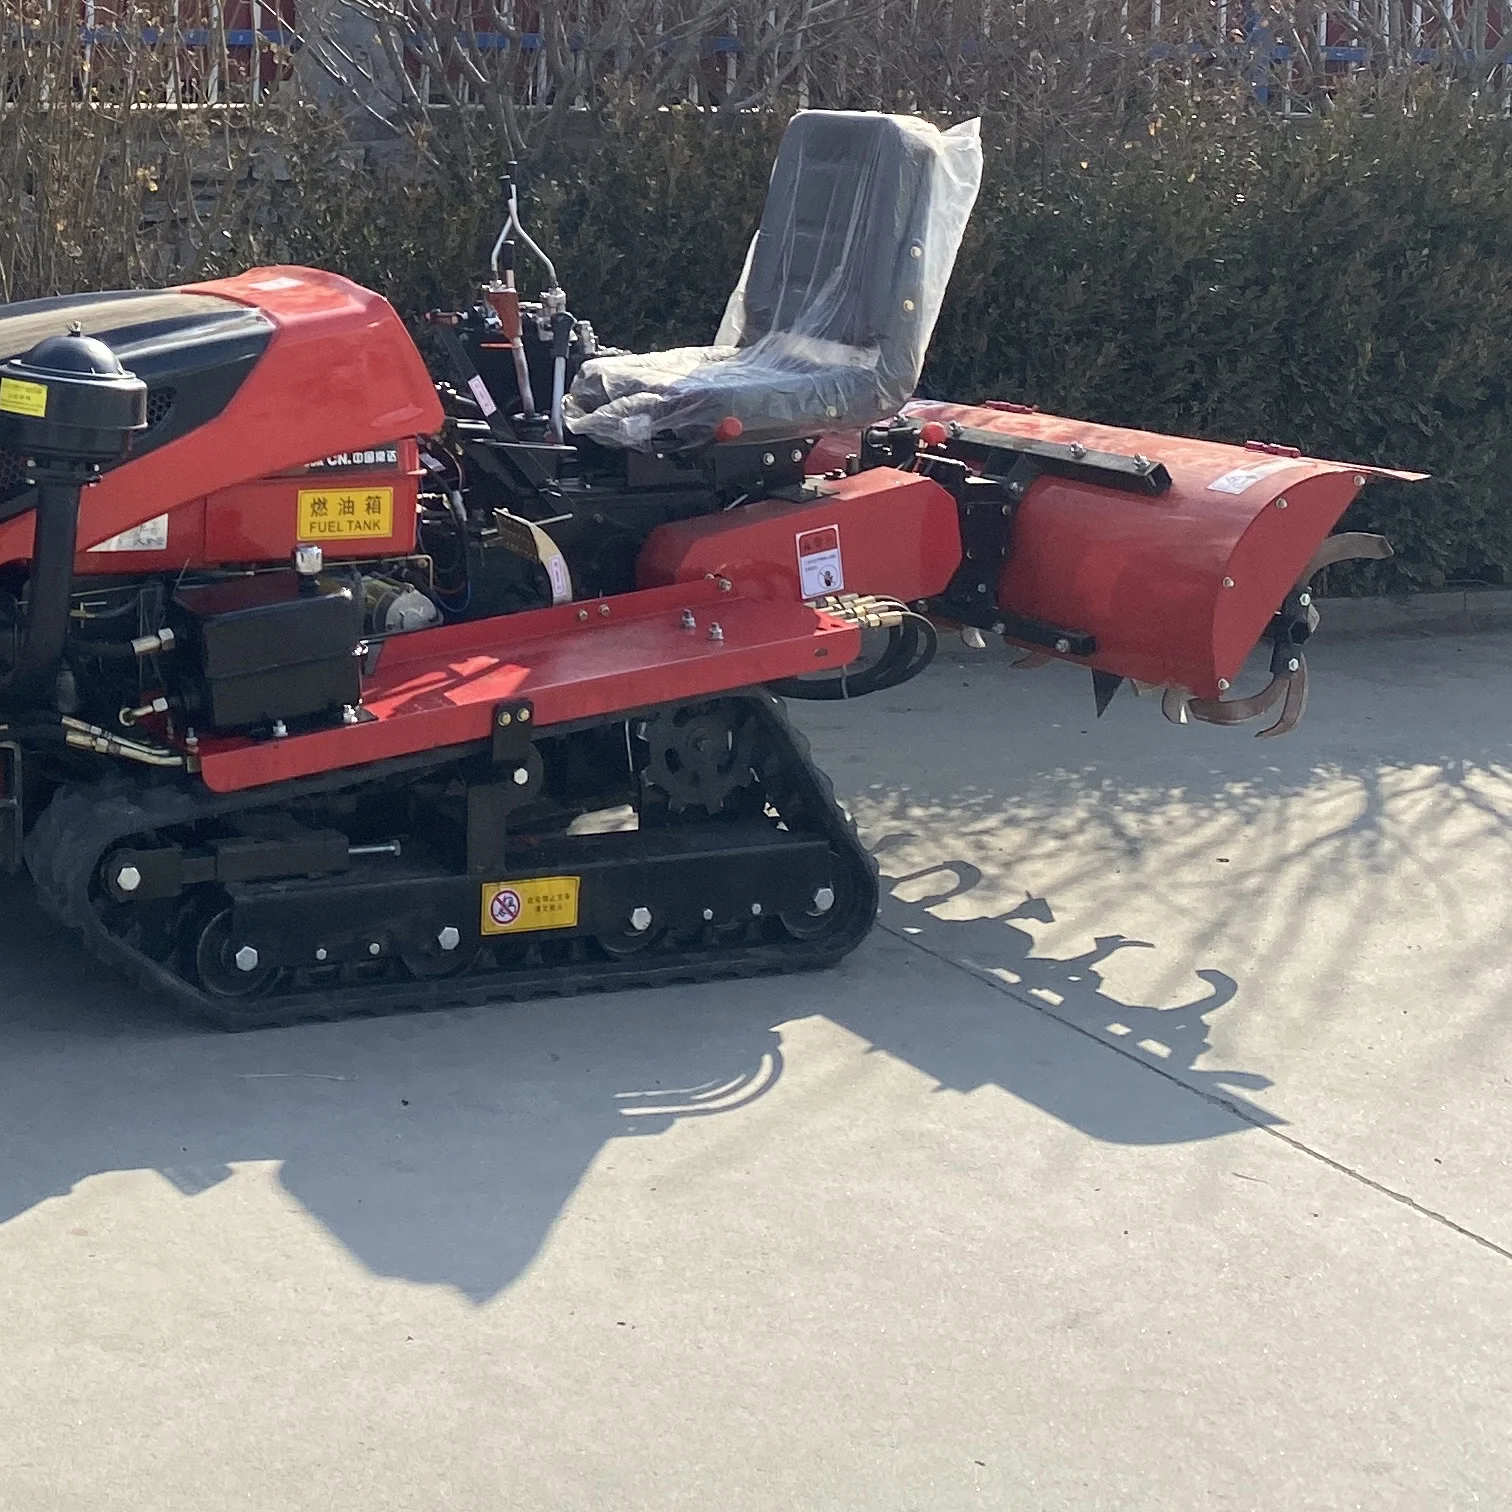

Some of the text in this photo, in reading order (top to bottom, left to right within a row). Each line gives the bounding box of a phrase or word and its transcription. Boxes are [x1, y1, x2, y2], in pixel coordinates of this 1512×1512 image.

[310, 496, 381, 517] 燃油箱
[309, 519, 380, 533] FUEL TANK
